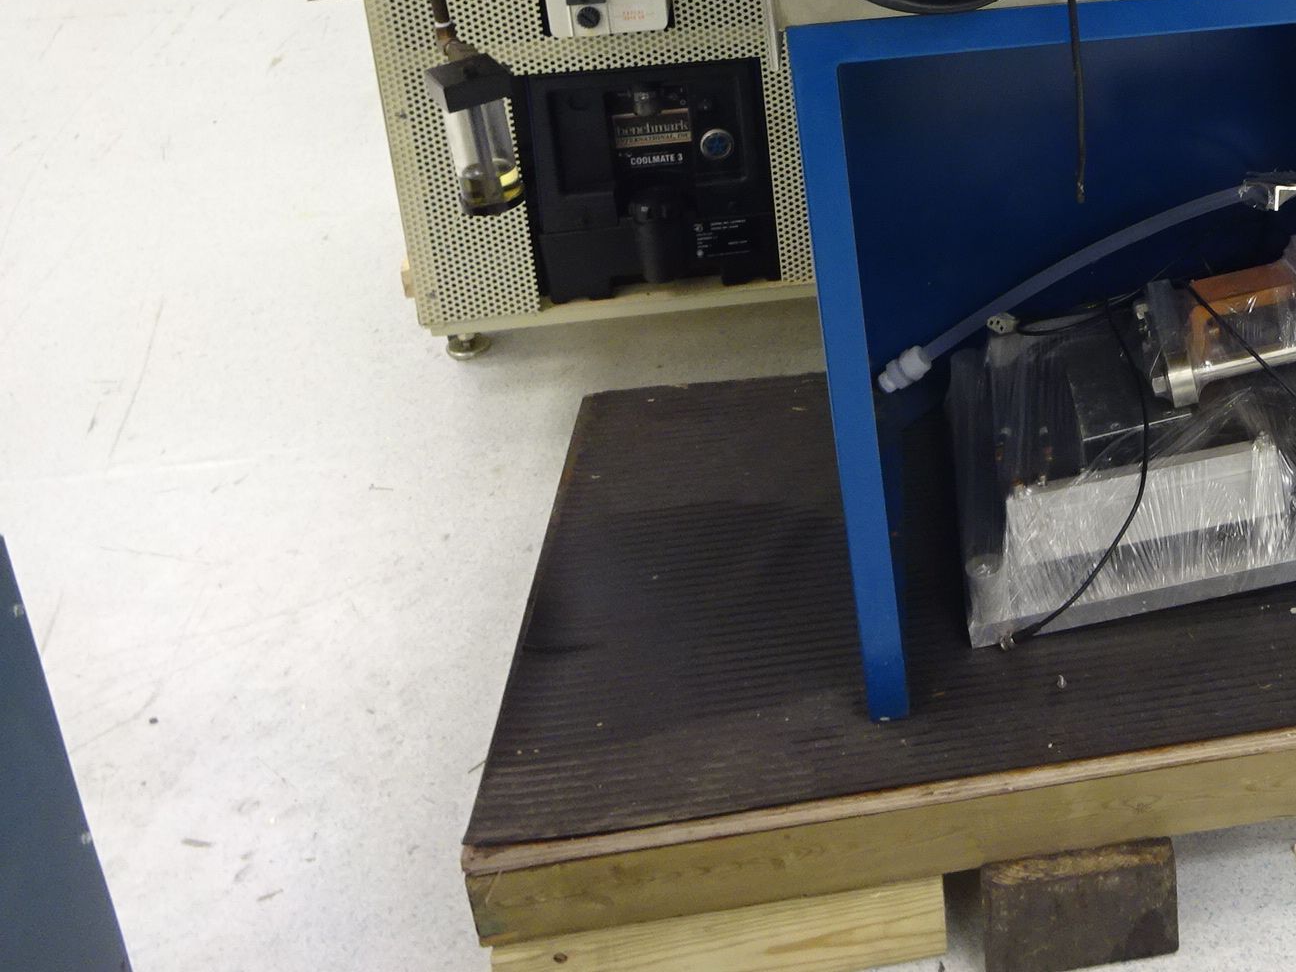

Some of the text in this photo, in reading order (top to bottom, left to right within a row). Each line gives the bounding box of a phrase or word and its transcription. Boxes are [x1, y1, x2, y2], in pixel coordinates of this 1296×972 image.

[616, 119, 689, 136] benchmark
[630, 155, 675, 166] COOLMATE
[676, 153, 684, 162] 3
